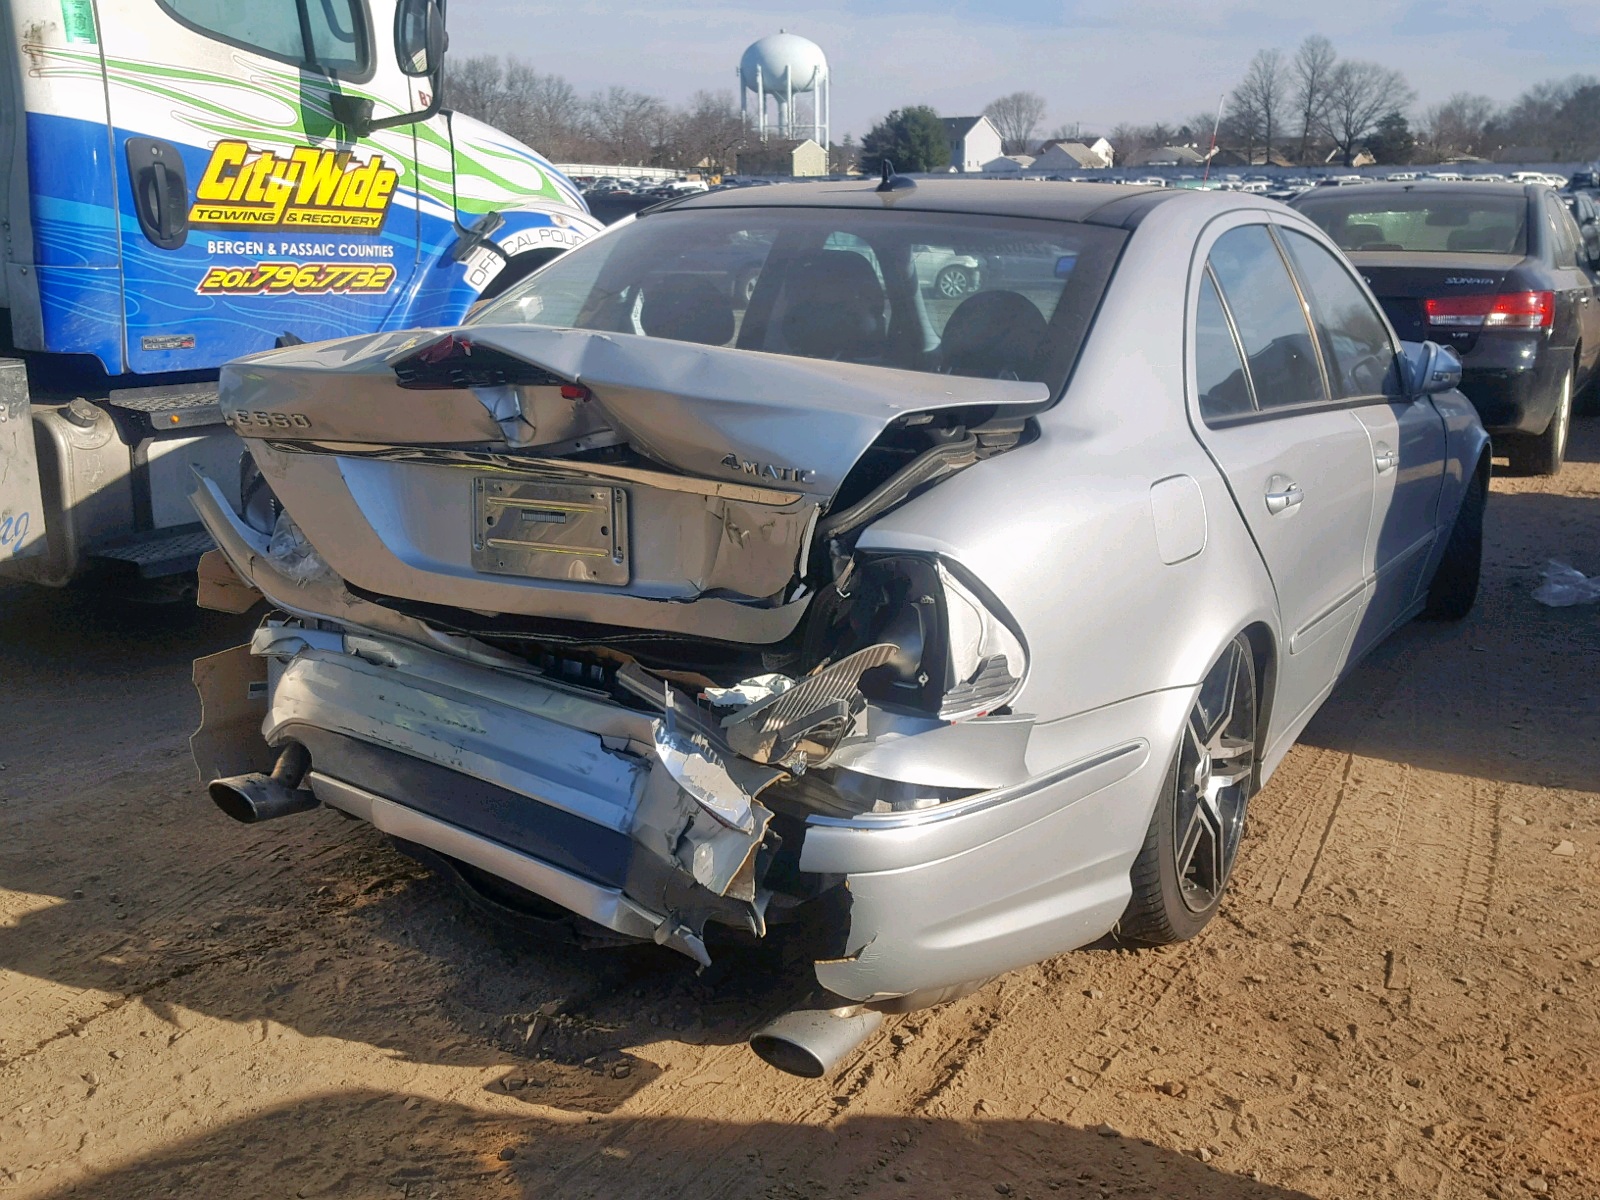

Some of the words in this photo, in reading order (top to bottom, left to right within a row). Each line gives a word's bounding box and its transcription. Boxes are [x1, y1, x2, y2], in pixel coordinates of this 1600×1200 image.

[197, 209, 275, 222] TOWING
[286, 213, 297, 222] &
[301, 213, 379, 226] RECOVERY
[207, 240, 263, 255] BERGEN
[267, 243, 276, 255] &
[281, 244, 335, 257] PASSAIC
[338, 245, 394, 257] COUNTIES
[202, 265, 394, 289] 201.796.7732
[720, 452, 816, 485] 4MATIC
